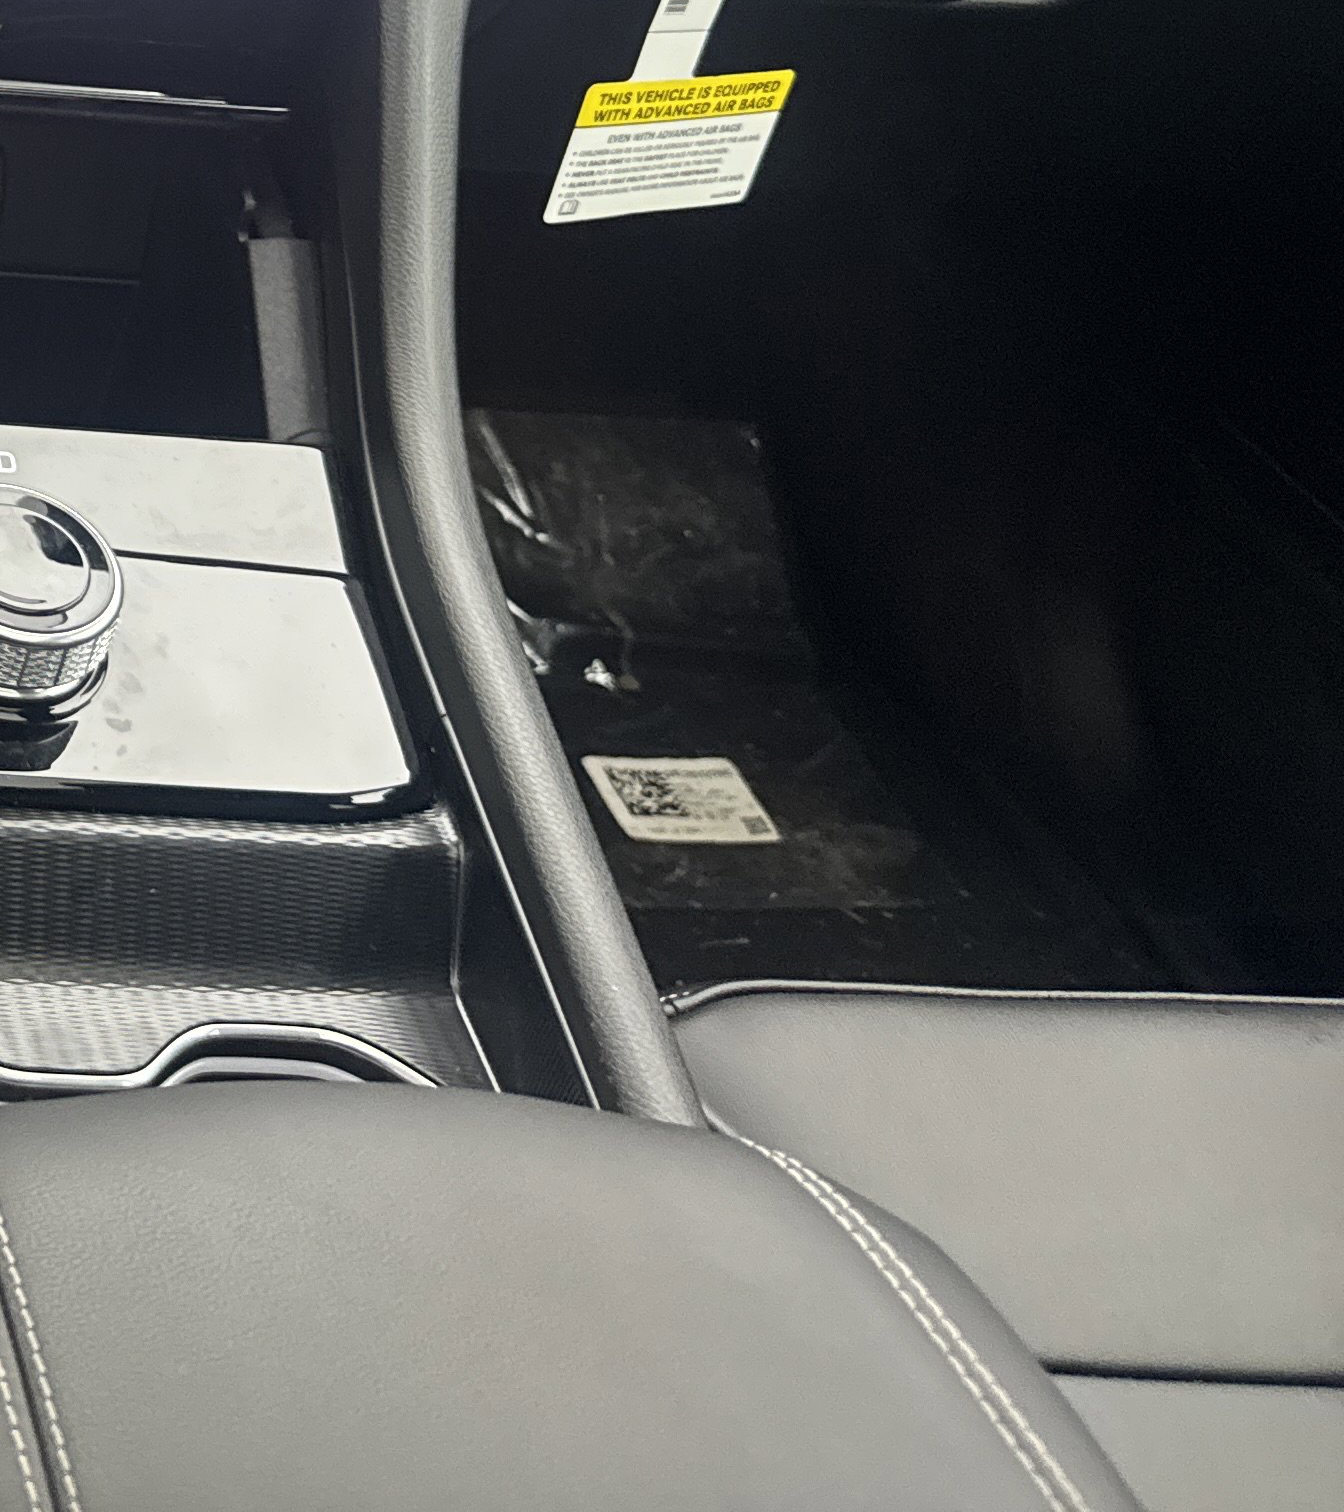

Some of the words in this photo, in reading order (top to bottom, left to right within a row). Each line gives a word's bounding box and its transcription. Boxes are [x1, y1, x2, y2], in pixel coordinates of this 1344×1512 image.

[599, 92, 632, 106] THIS
[636, 87, 694, 104] VEHICLE
[697, 85, 710, 99] IS
[715, 80, 781, 98] EQUIPPED
[593, 109, 630, 122] WITH
[634, 102, 710, 120] ADVANCED
[712, 99, 736, 112] AIR
[738, 96, 774, 111] BAGS
[607, 132, 631, 143] EVEN
[660, 125, 703, 140] ADVANCED
[720, 123, 742, 134] BAGS
